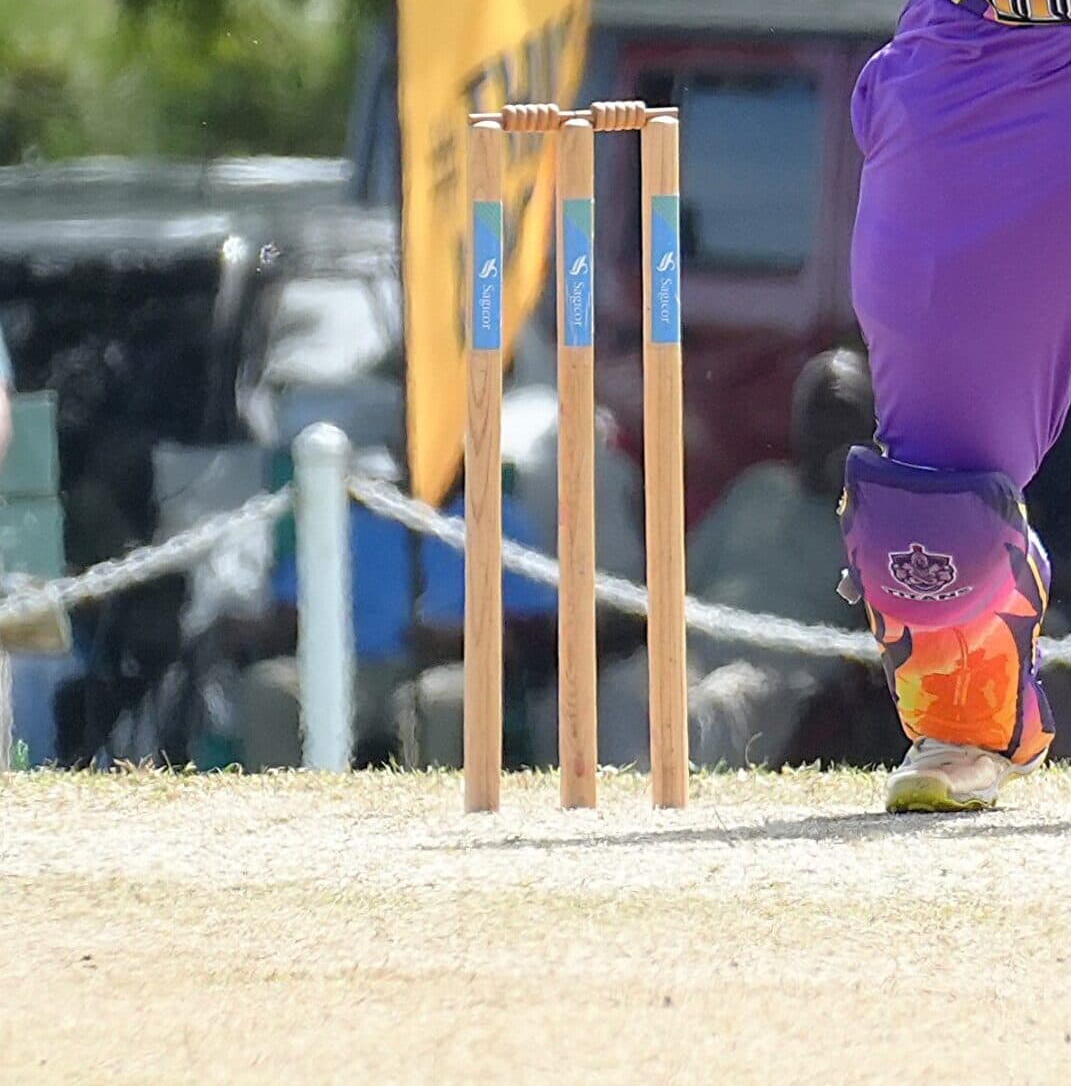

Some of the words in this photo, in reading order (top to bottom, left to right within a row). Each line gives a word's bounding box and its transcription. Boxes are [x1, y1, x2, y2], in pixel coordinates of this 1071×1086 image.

[479, 284, 495, 330] Sagicor
[569, 281, 585, 327] Sagicor
[658, 278, 673, 324] Sagicor
